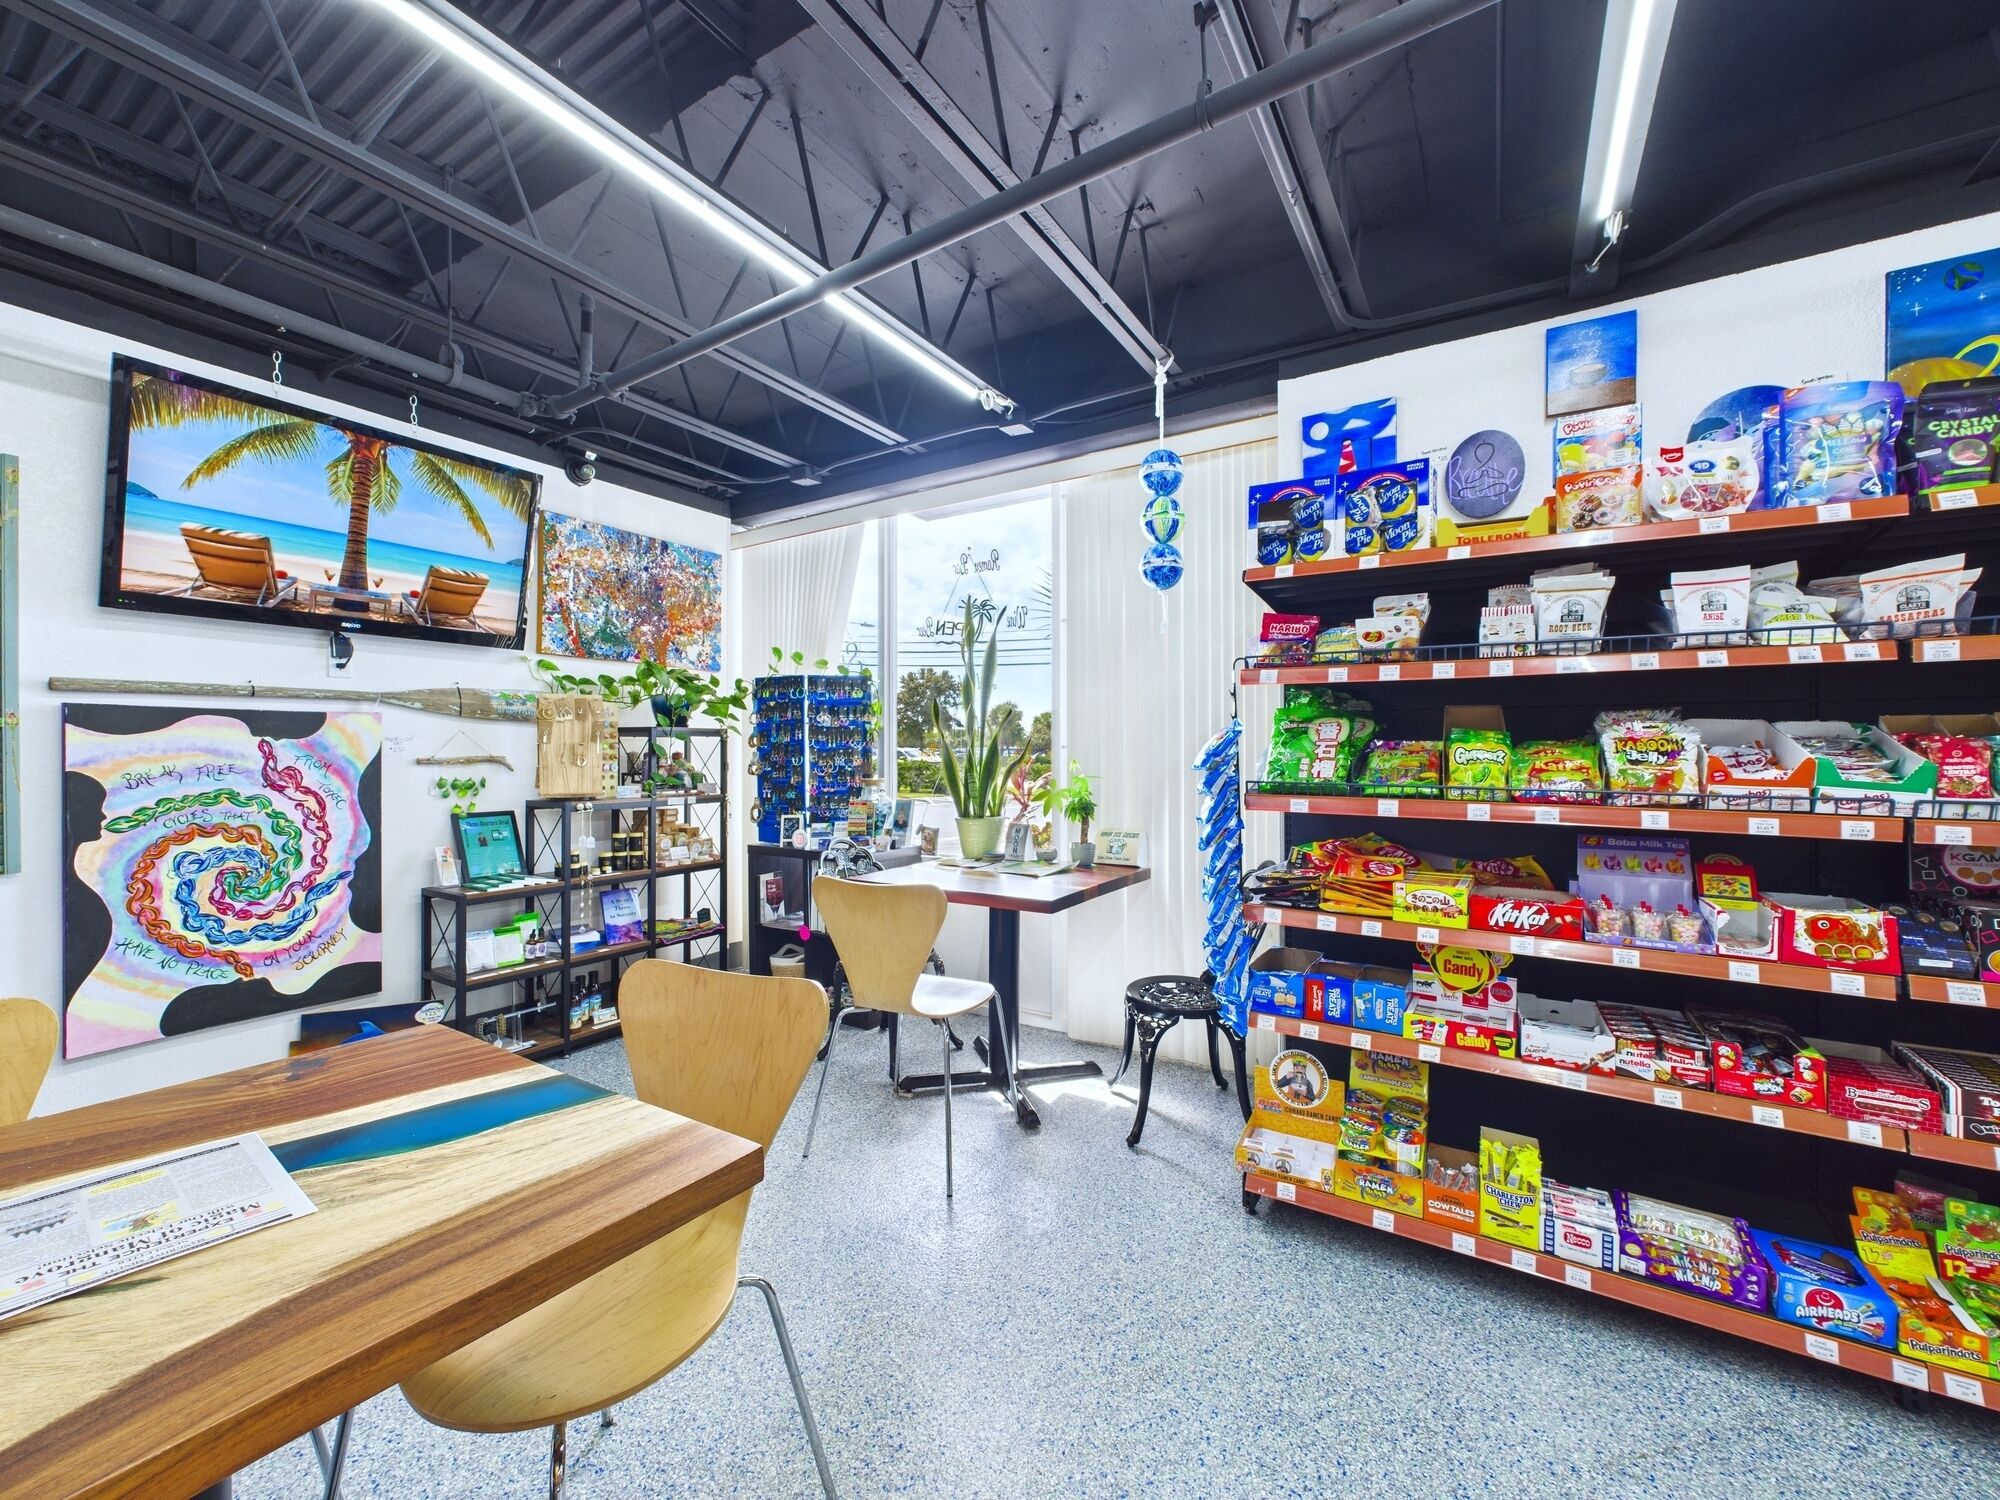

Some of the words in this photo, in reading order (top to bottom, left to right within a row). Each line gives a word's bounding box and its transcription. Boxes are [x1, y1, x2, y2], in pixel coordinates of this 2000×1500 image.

[1936, 424, 1995, 439] CANDY
[1402, 528, 1417, 543] Pie
[1456, 530, 1530, 545] TOBLERONE
[1703, 612, 1724, 621] ANISE
[1879, 608, 1946, 622] SASSAFRAS
[341, 621, 361, 629] SANYO
[1270, 623, 1309, 634] HARIBO
[1548, 624, 1568, 633] ROOT
[1572, 623, 1592, 632] BEER
[294, 754, 333, 773] FROM
[1625, 751, 1668, 765] Jelly
[1727, 757, 1763, 769] mbos
[121, 765, 184, 790] BREAK
[196, 763, 246, 782] FREE
[163, 808, 213, 829] CYCLES
[219, 810, 255, 822] THAT
[1012, 828, 1021, 854] MOON
[1607, 837, 1637, 847] Boba
[1639, 839, 1663, 848] Milk
[1665, 841, 1685, 849] Tea
[1951, 852, 2000, 862] KGAM
[1411, 893, 1450, 906] きのこの山
[1489, 901, 1550, 929] KitKat
[263, 949, 281, 967] ON
[283, 929, 322, 959] YOUR
[295, 928, 347, 971] JOURNEY
[1635, 939, 1651, 947] Boba
[115, 936, 153, 961] HAVE
[160, 954, 181, 970] NO
[185, 962, 229, 979] PLACE
[1443, 958, 1483, 982] Candy
[1328, 989, 1336, 1017] TREATS
[1385, 998, 1393, 1024] TREATS
[1456, 1032, 1491, 1051] Candy
[1371, 1051, 1409, 1067] RAMEN
[1619, 1058, 1651, 1068] nutella
[1360, 1073, 1378, 1081] CANDY
[1379, 1077, 1401, 1086] NOODLE
[1753, 1083, 1784, 1095] PANDA
[1359, 1177, 1393, 1195] RAMEN
[1486, 1184, 1535, 1205] CHARLESTON
[1428, 1200, 1450, 1211] COW
[1450, 1205, 1475, 1218] TALES
[1499, 1198, 1521, 1209] CHEW
[190, 1198, 260, 1229] Magic
[108, 1216, 234, 1261] EXPERIENCE
[157, 1225, 184, 1240] of
[1861, 1230, 1921, 1248] Pulparindots
[13, 1234, 151, 1287] Mangrove
[1945, 1243, 2000, 1263] Pulparindo
[56, 1259, 101, 1278] THE
[1796, 1305, 1860, 1324] AIRHEADS
[1910, 1338, 1981, 1361] Pulparindots
